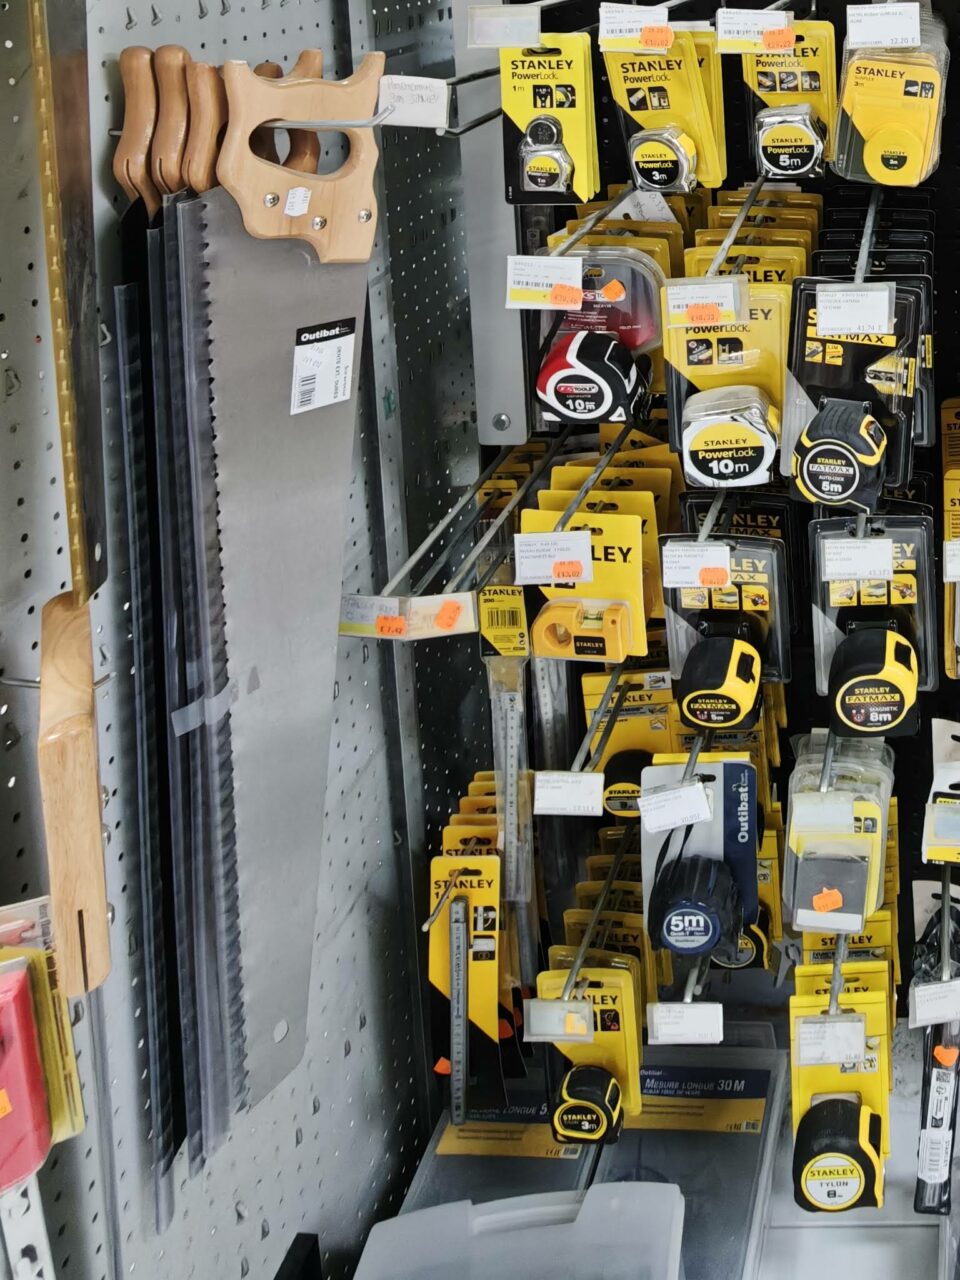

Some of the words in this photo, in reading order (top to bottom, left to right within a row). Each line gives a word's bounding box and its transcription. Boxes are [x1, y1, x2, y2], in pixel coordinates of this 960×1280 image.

[511, 59, 573, 70] STANLEY
[621, 59, 683, 73] STANLEY
[755, 59, 804, 68] PowerLock
[511, 71, 558, 81] PowerLock
[855, 66, 906, 79] STANLEY
[623, 74, 671, 84] PowerLock
[767, 146, 810, 154] PowerLock
[779, 154, 801, 167] 5m
[528, 165, 558, 173] STANLEY
[651, 171, 667, 180] 3m
[685, 323, 751, 334] PowerLock
[301, 327, 340, 342] Outibat
[704, 438, 748, 447] STANLEY
[698, 448, 757, 460] PowerLock
[817, 457, 846, 465] STANLEY
[708, 461, 749, 474] 10m
[809, 465, 853, 474] FATMAX
[821, 481, 842, 493] 5m
[481, 589, 523, 597] STANLEY
[854, 686, 890, 695] STANLEY
[848, 694, 897, 703] FATMAX
[870, 711, 892, 722] 8m
[737, 786, 749, 843] Outibat
[434, 878, 494, 889] STANLEY
[670, 914, 705, 932] 5m
[717, 1079, 732, 1091] 30
[563, 1113, 598, 1122] STANLEY
[809, 1167, 855, 1178] STANLEY
[818, 1180, 849, 1188] TYLON
